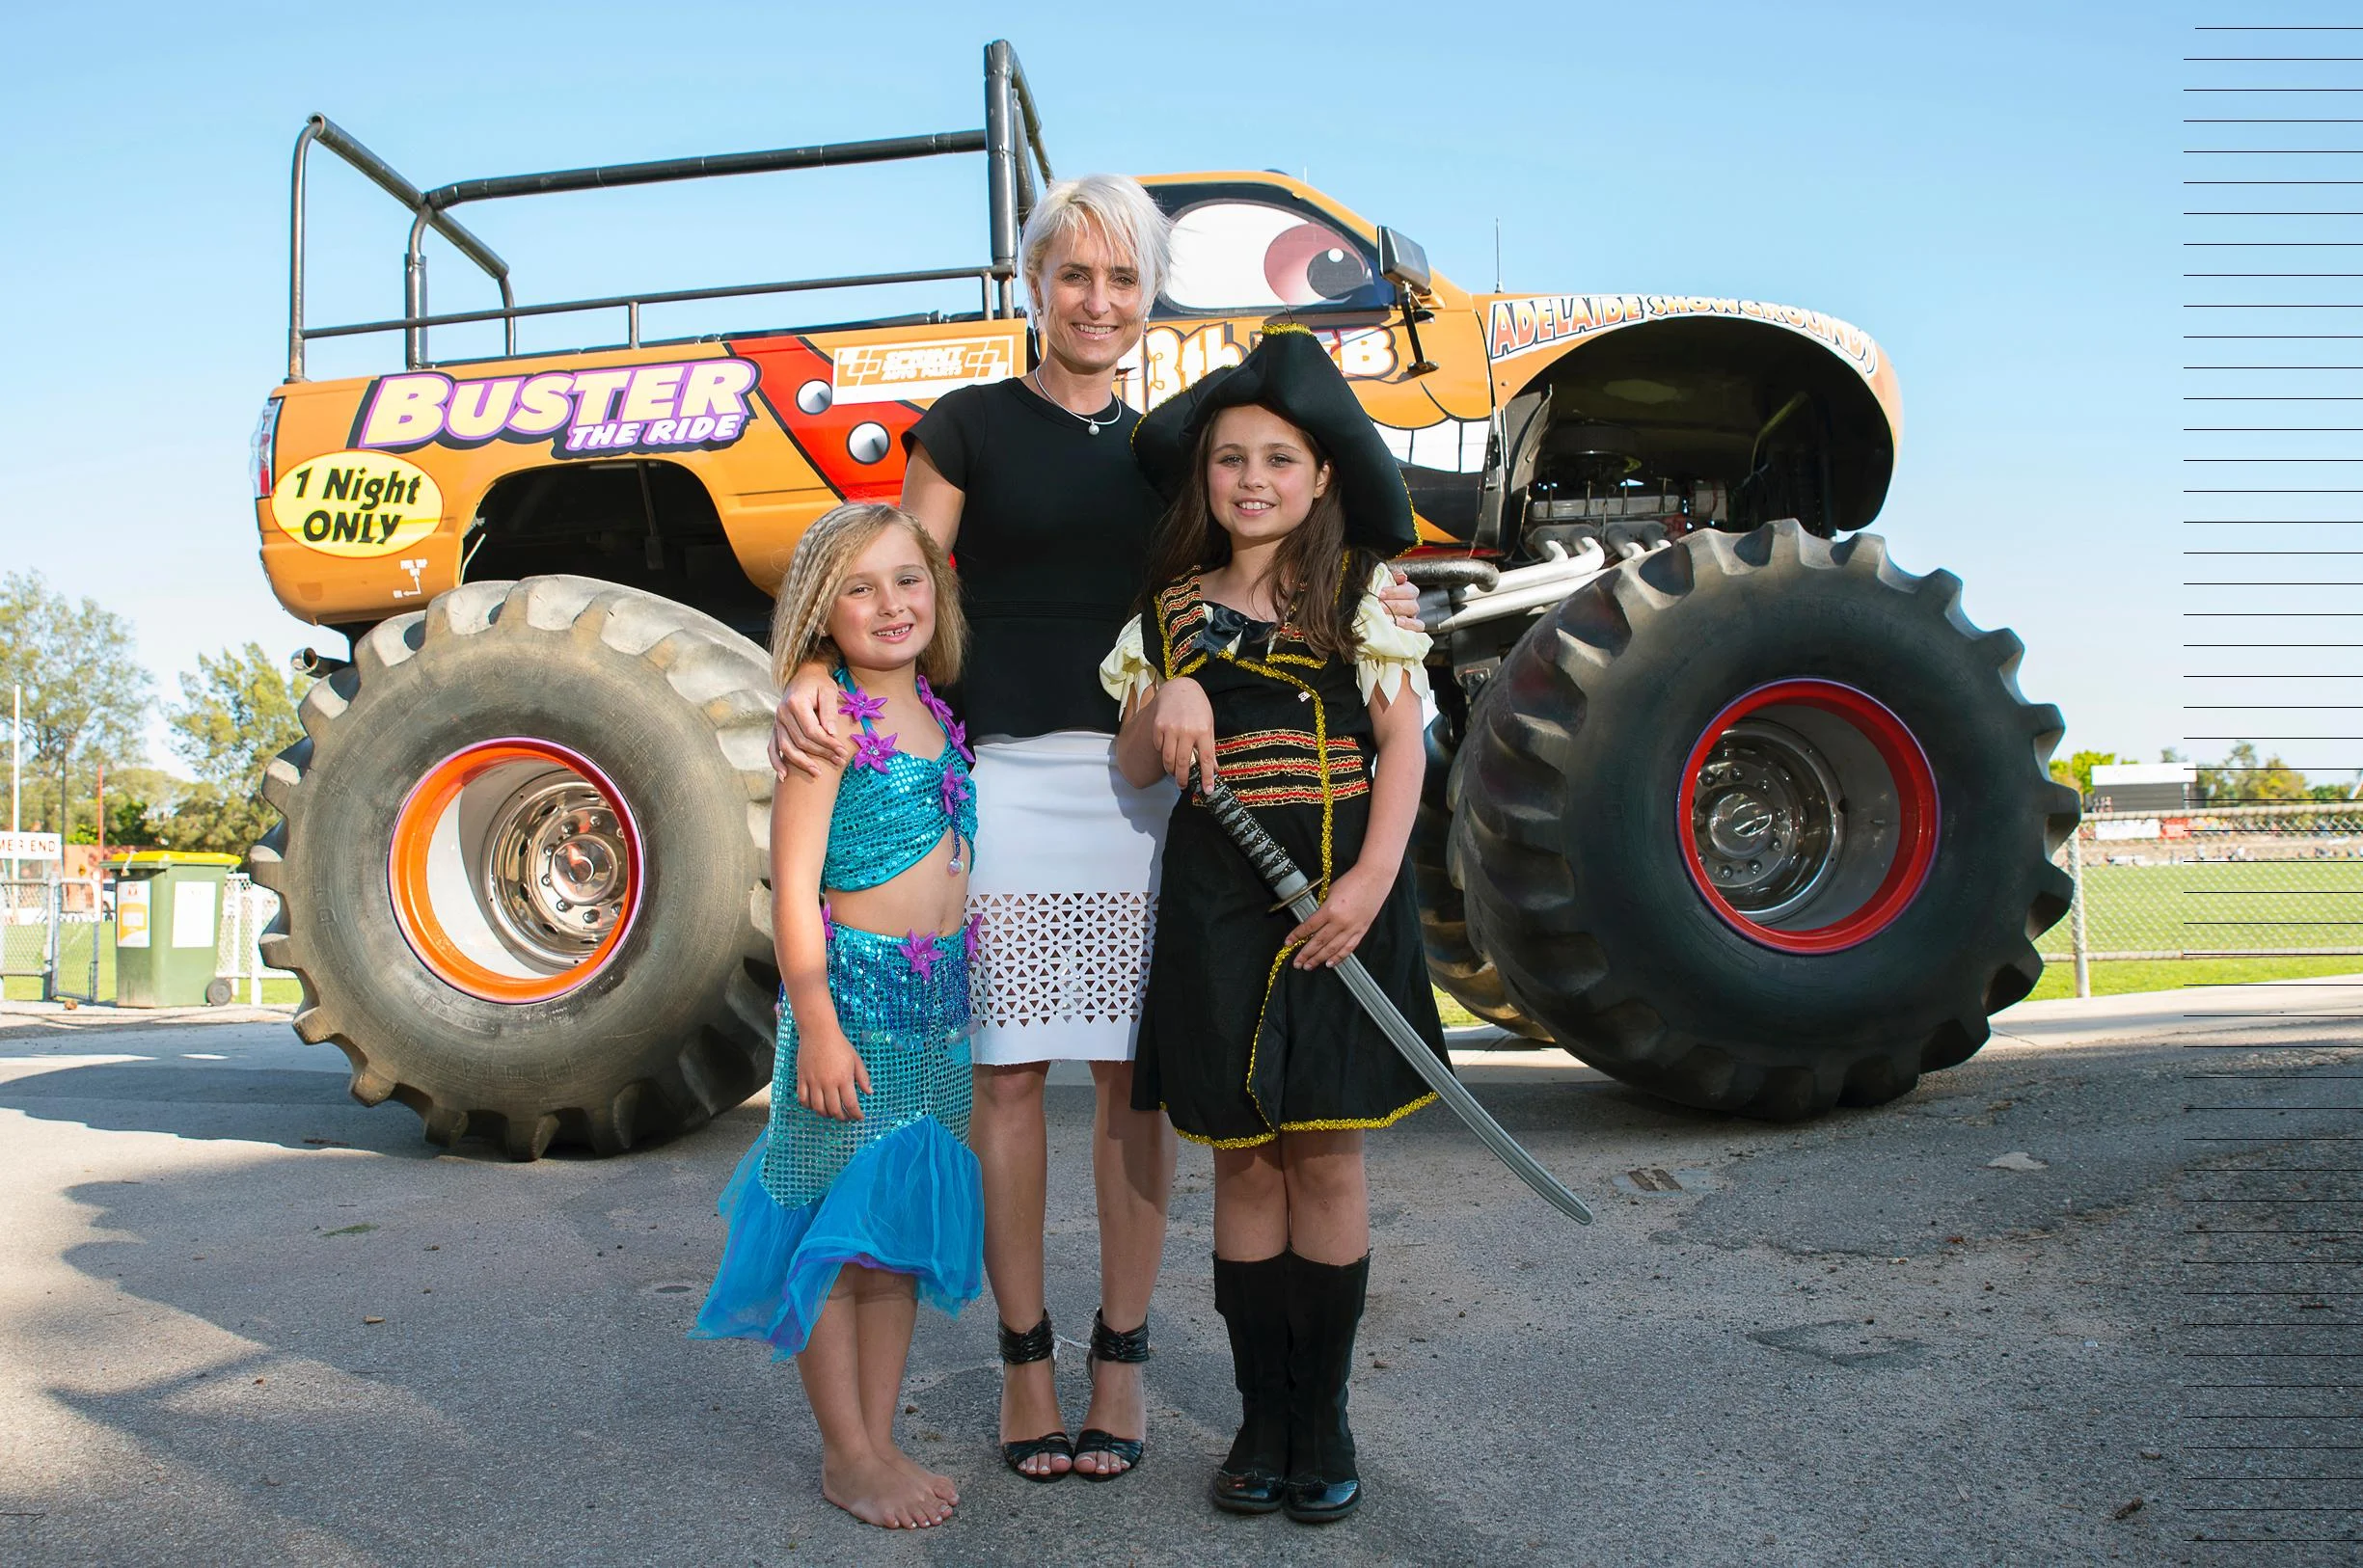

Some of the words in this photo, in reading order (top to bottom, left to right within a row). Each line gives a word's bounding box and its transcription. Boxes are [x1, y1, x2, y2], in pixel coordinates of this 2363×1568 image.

[1491, 295, 1644, 360] ADELAIDE
[1647, 295, 1877, 374] SHOWGROUNDS
[359, 361, 757, 447] BUSTER
[571, 422, 640, 449] THE
[647, 415, 741, 443] RIDE
[296, 467, 312, 499] 1
[322, 467, 422, 511] Night
[304, 510, 402, 545] ONLY
[30, 840, 56, 852] END
